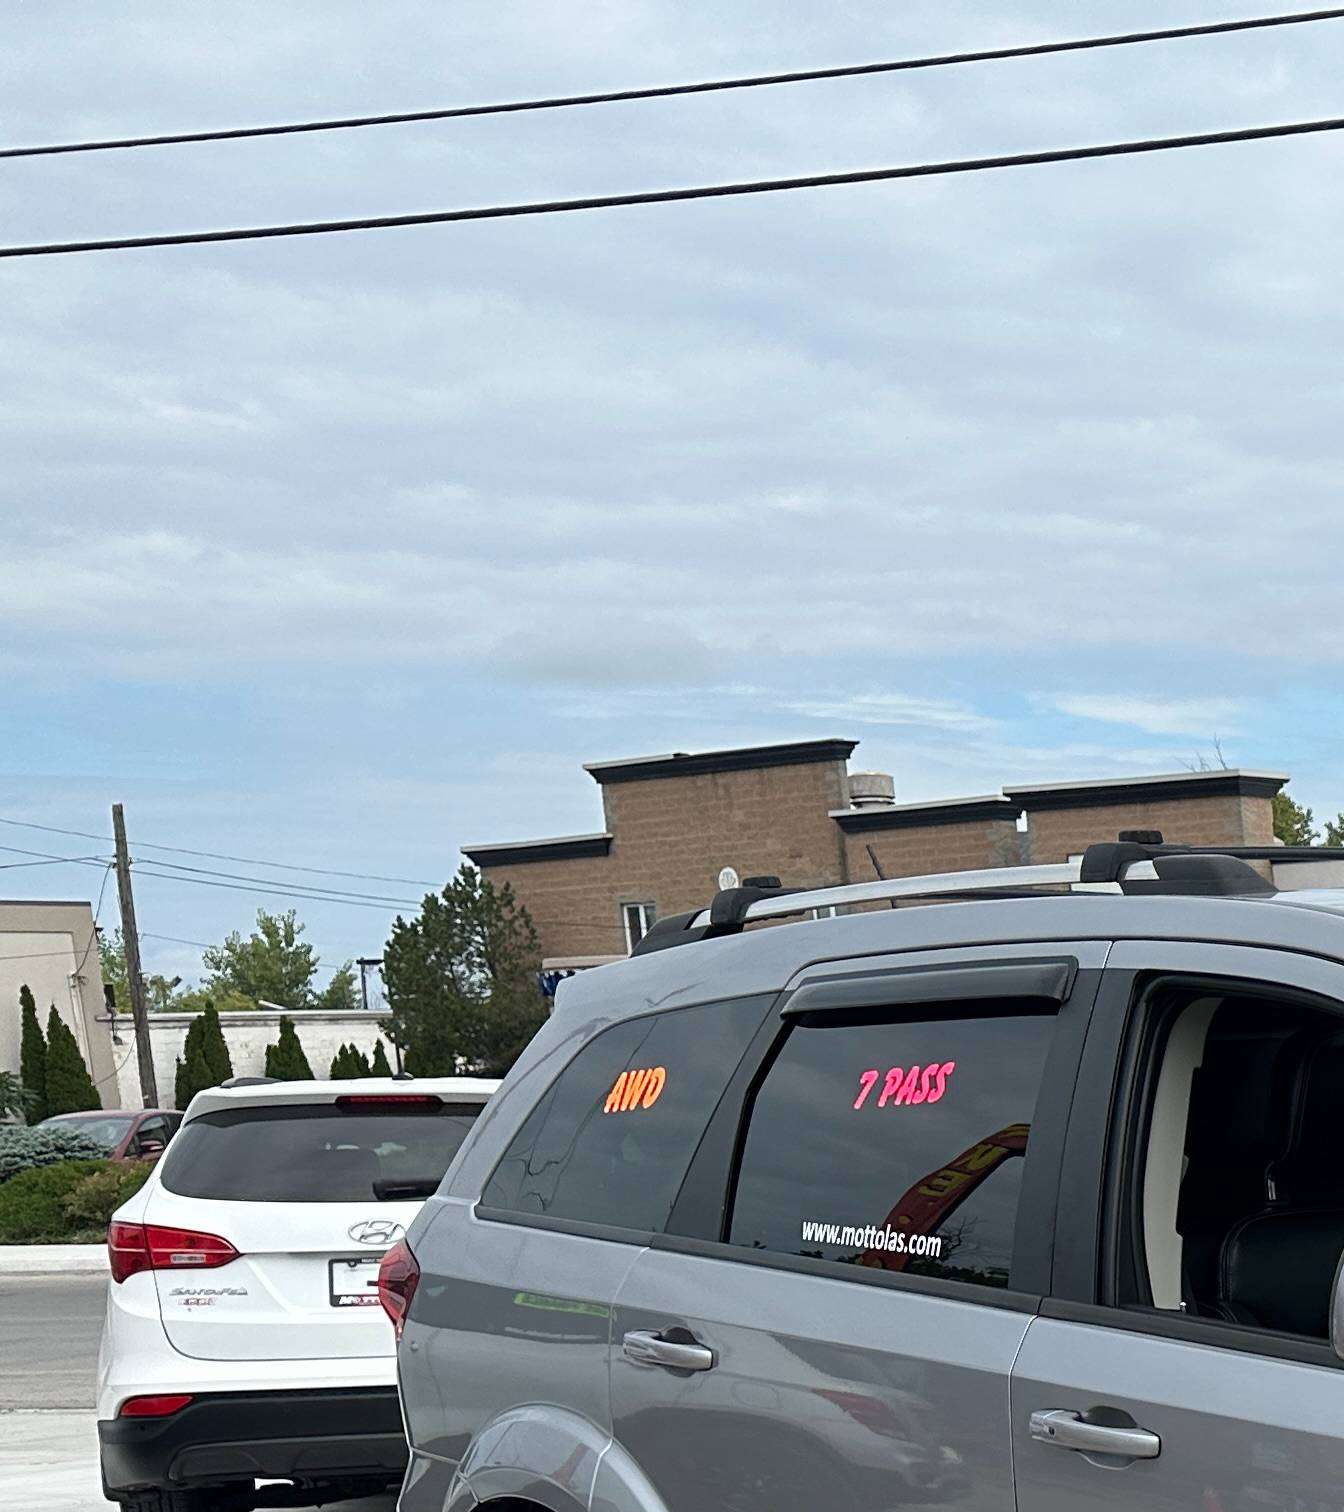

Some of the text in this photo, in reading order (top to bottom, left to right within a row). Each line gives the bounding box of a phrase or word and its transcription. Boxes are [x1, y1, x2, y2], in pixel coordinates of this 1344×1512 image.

[604, 1066, 666, 1113] AWD
[853, 1061, 956, 1110] 7 PASS
[802, 1221, 942, 1258] www.mottolas.com
